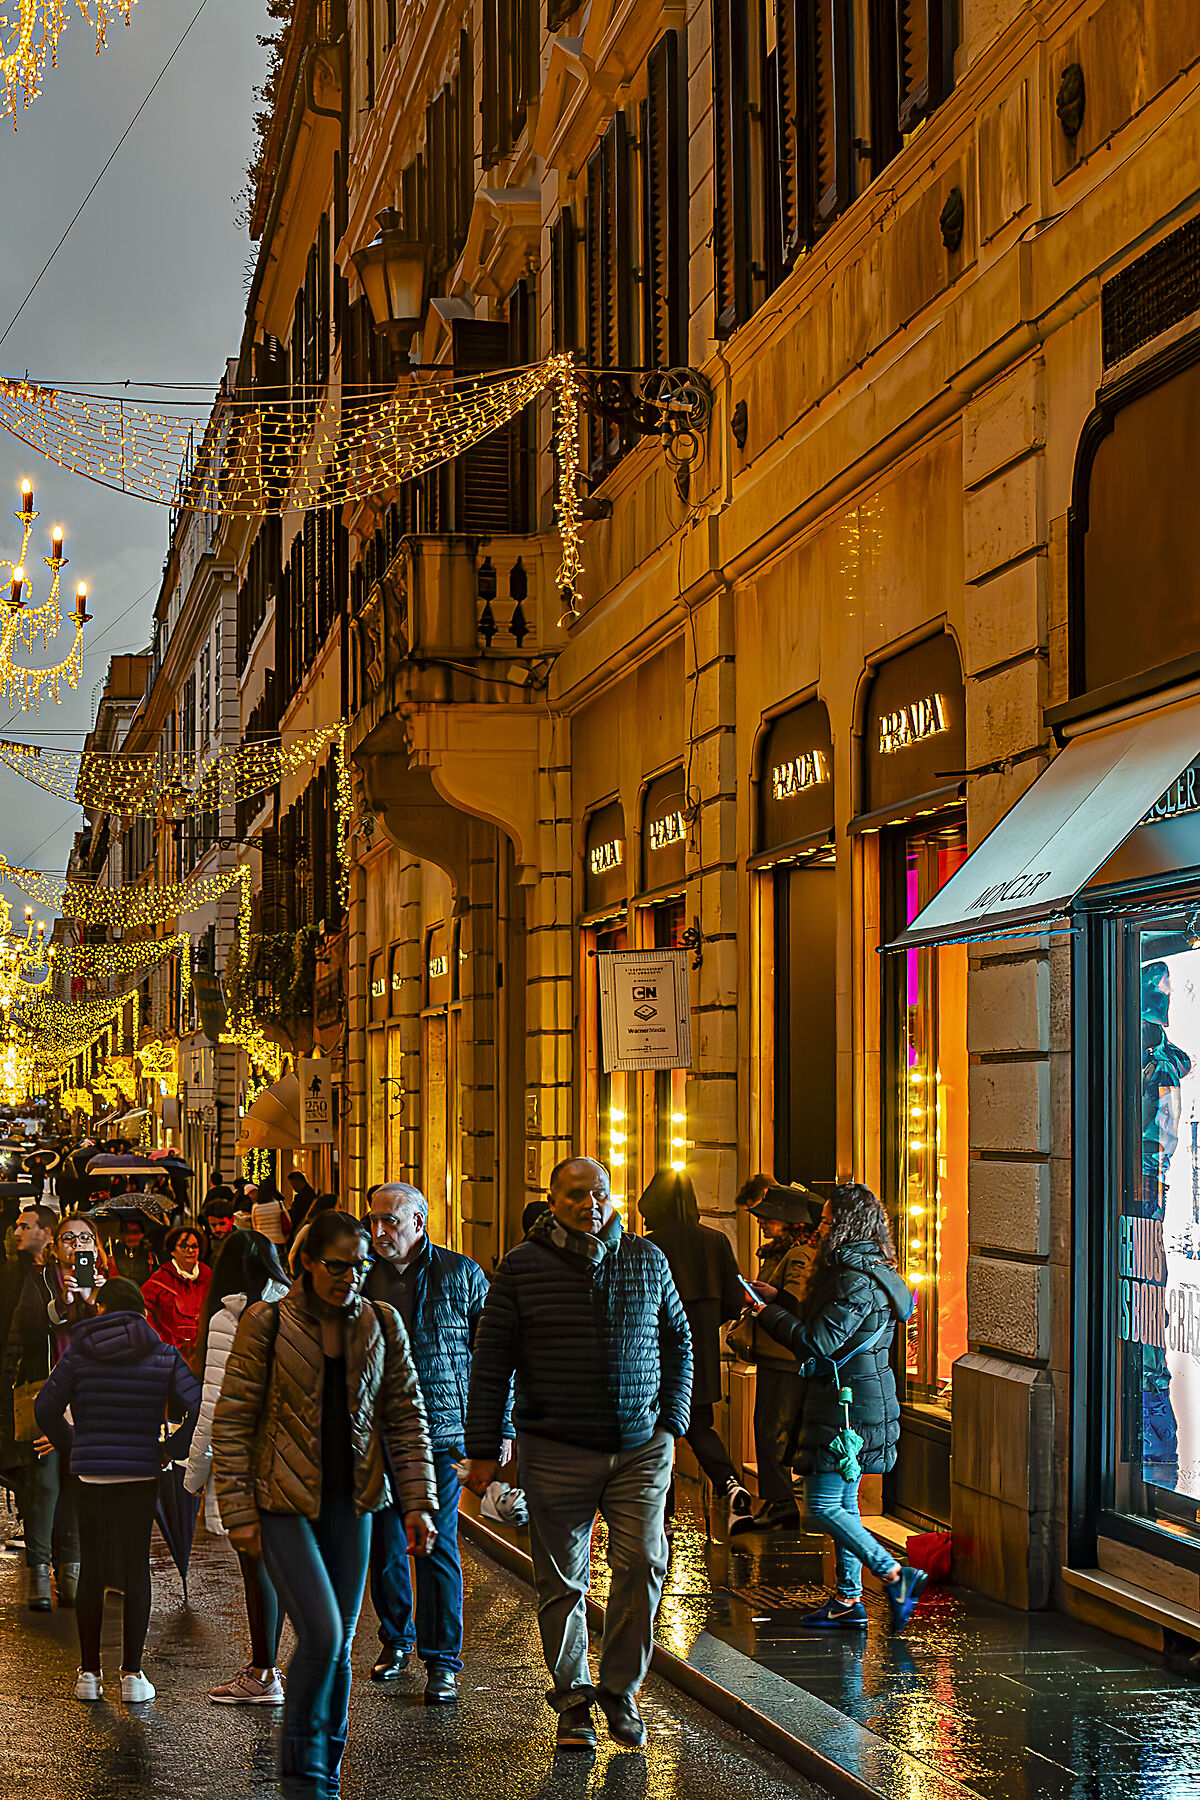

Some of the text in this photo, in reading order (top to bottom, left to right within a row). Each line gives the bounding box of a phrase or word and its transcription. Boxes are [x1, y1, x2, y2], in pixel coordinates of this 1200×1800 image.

[879, 693, 949, 754] PRADA
[773, 750, 830, 800] PRADA
[964, 871, 1052, 922] MONCLER
[632, 986, 657, 1000] CN
[305, 1101, 327, 1112] 250
[1118, 1214, 1164, 1282] GENIUS
[1117, 1278, 1130, 1341] IS
[1131, 1280, 1166, 1349] BORN
